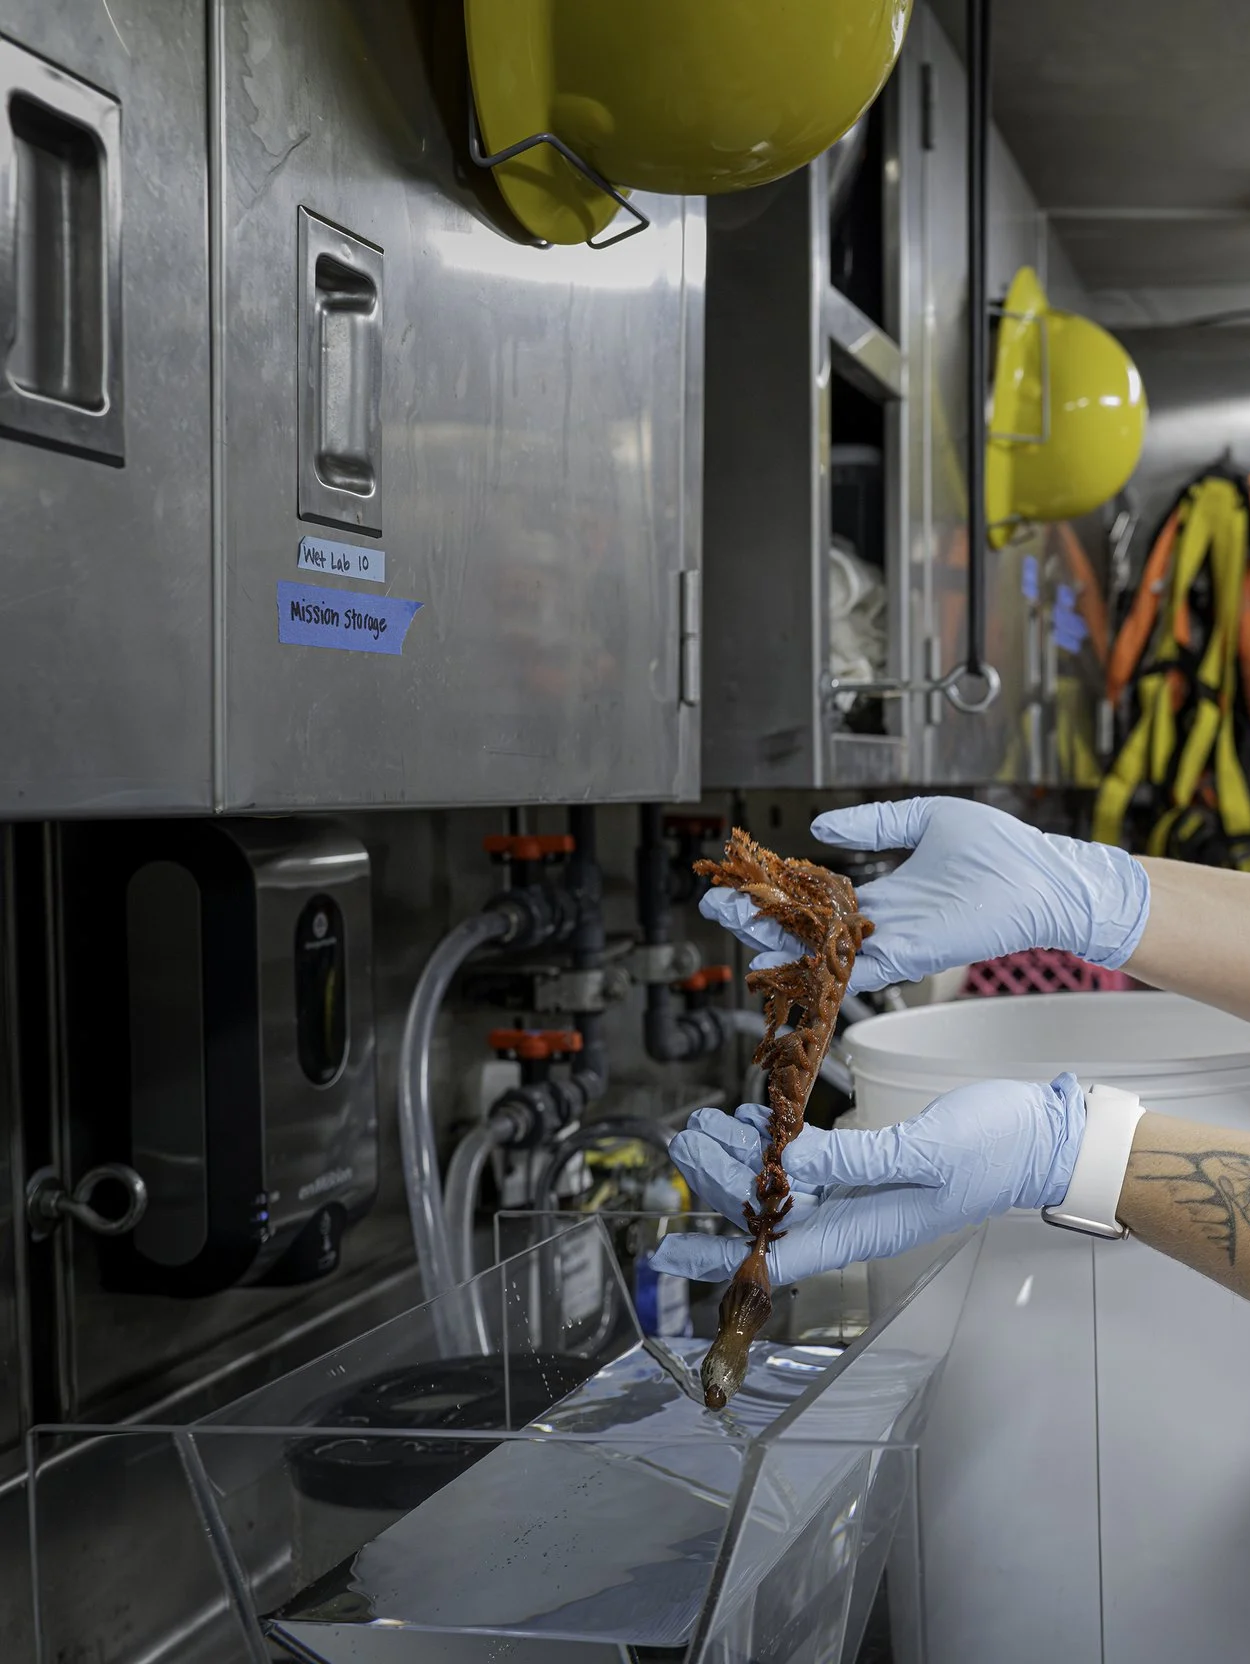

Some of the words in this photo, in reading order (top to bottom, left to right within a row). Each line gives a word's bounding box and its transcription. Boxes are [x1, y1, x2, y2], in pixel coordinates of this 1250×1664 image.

[303, 545, 327, 569] Wet
[330, 551, 351, 573] Lab
[358, 555, 369, 571] 10
[290, 598, 340, 627] Mission
